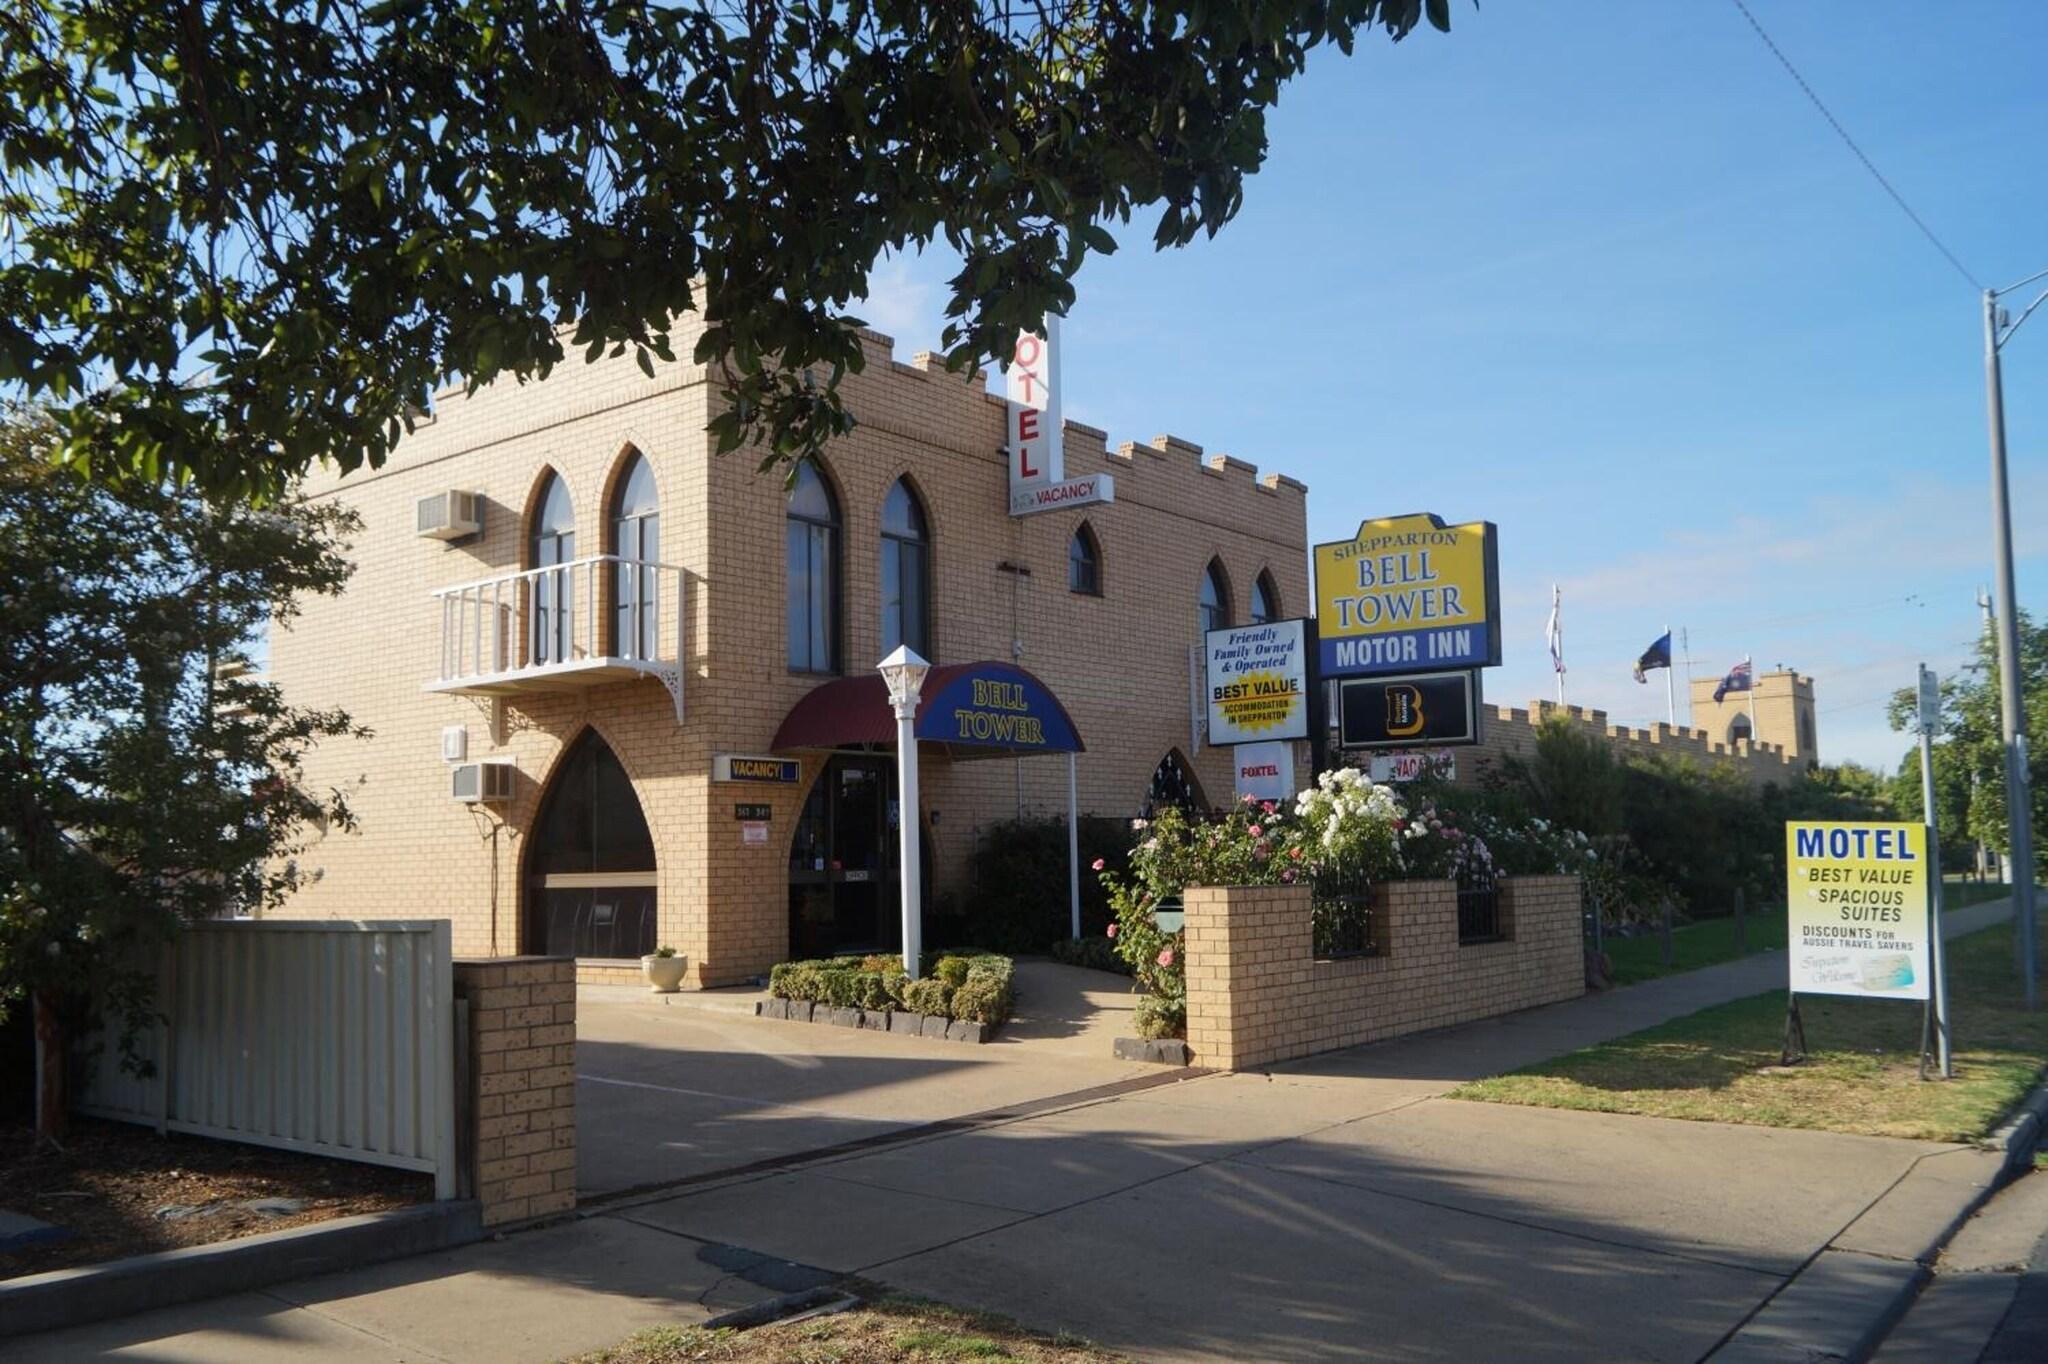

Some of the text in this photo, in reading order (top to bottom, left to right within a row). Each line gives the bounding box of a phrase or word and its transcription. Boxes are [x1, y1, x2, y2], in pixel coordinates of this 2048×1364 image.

[1014, 334, 1040, 479] OTEL
[1036, 481, 1095, 506] VACANCY
[1333, 531, 1459, 562] SHEPPARTON
[1358, 550, 1438, 588] BELL
[1334, 585, 1466, 629] TOWER
[1228, 627, 1280, 645] Friendly
[1213, 638, 1295, 661] Family Owned
[1336, 629, 1471, 668] MOTOR INN
[1221, 653, 1288, 675] & Operated
[972, 678, 1028, 712] BELL
[1213, 677, 1300, 700] BEST VALUE
[1223, 700, 1290, 714] ACCOMMODATION
[954, 708, 1047, 744] TOWER
[1228, 715, 1237, 725] IN
[732, 760, 780, 778] VACANCY
[1241, 764, 1279, 779] FOXTEL
[1796, 828, 1916, 860] MOTEL
[1809, 867, 1914, 885] BEST VALUE
[1818, 888, 1904, 906] SPACIOUS
[1840, 905, 1902, 923] SUITES
[1802, 925, 1895, 940] DISCOUNTS FOR
[1803, 937, 1914, 951] AUSSIE TRAVEL SAVERS
